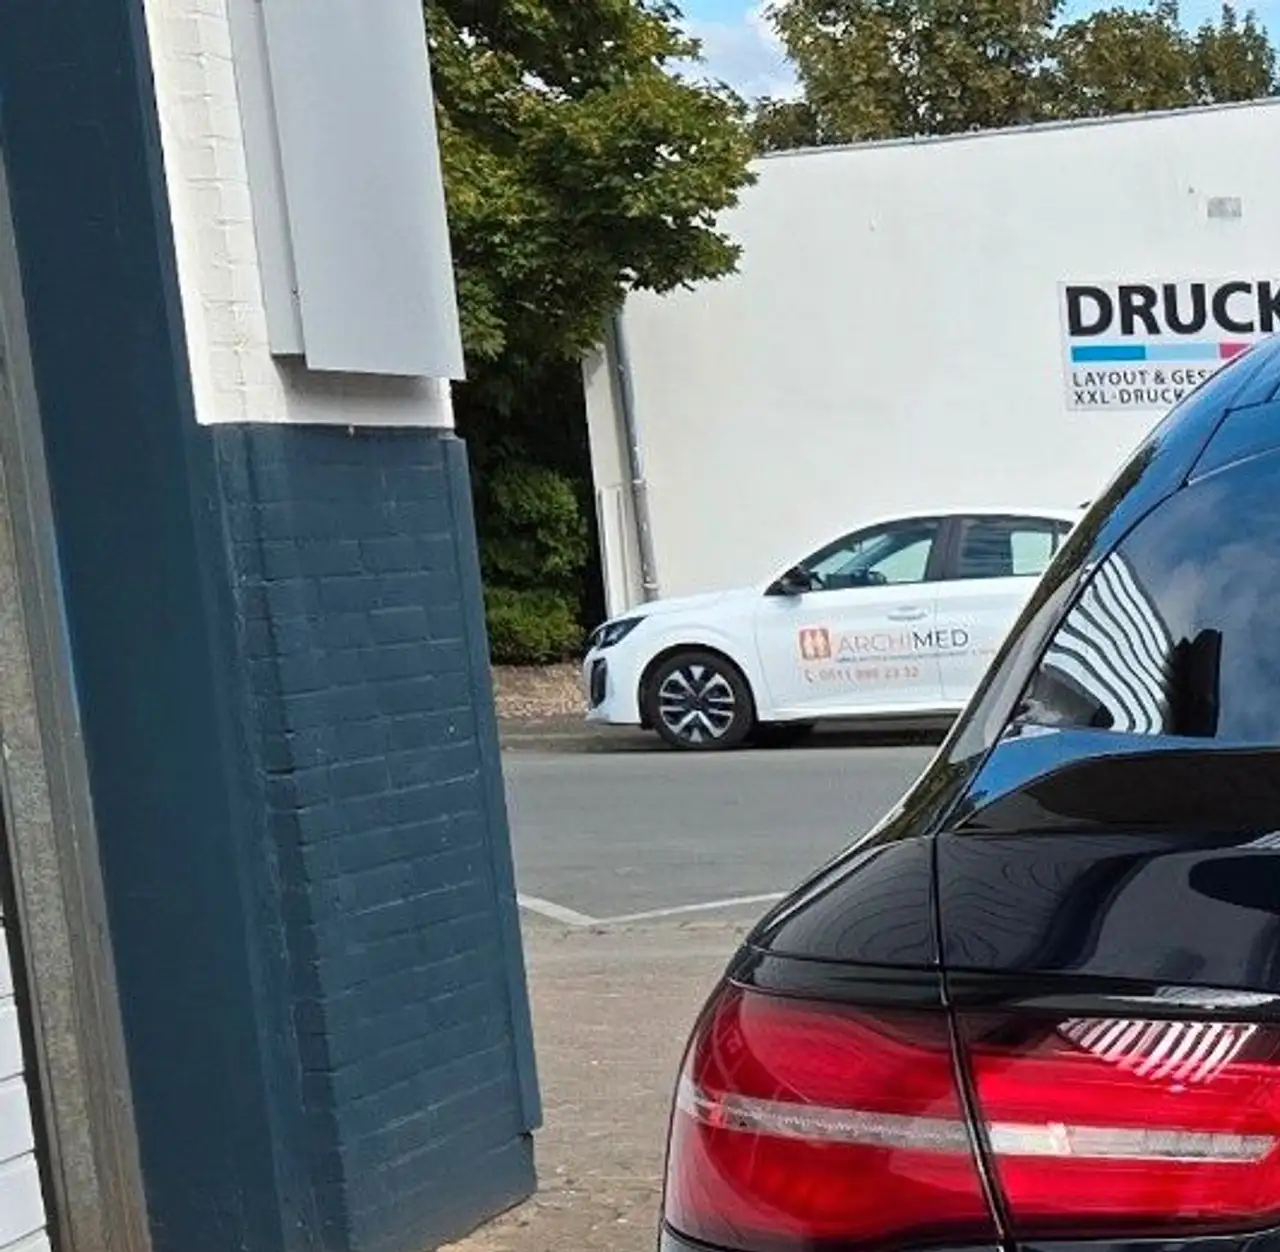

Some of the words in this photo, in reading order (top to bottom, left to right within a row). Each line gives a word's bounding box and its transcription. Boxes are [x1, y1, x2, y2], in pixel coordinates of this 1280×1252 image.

[1072, 370, 1149, 387] LAYOUT
[1154, 370, 1165, 385] &
[1171, 369, 1211, 386] GES
[839, 628, 969, 652] ARCHIMED
